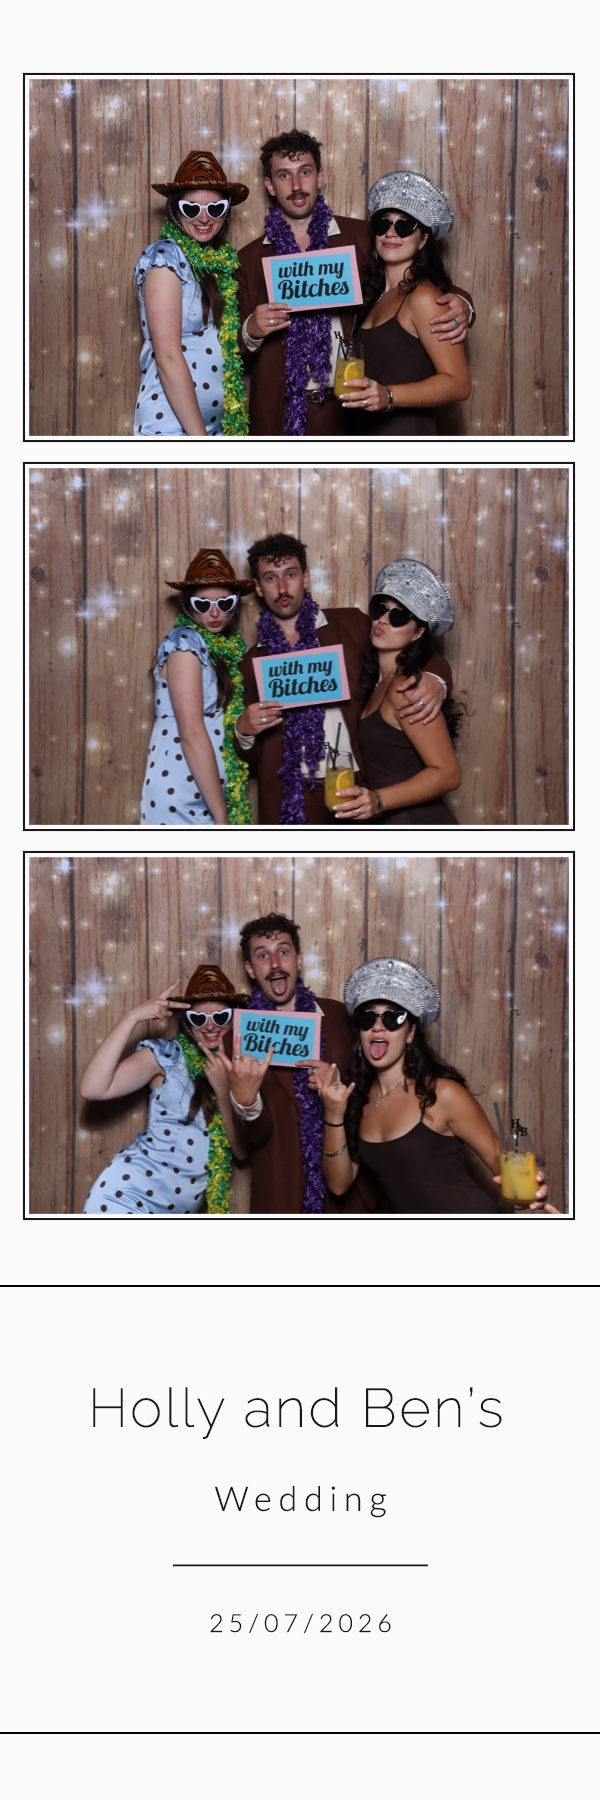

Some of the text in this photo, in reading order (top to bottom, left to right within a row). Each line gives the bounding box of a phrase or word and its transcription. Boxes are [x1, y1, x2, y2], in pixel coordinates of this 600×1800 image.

[278, 261, 344, 279] with my
[278, 278, 350, 300] Bitches
[268, 660, 333, 677] with my
[268, 676, 338, 698] Bitches
[246, 1018, 309, 1042] with my
[243, 1032, 310, 1058] Bitches
